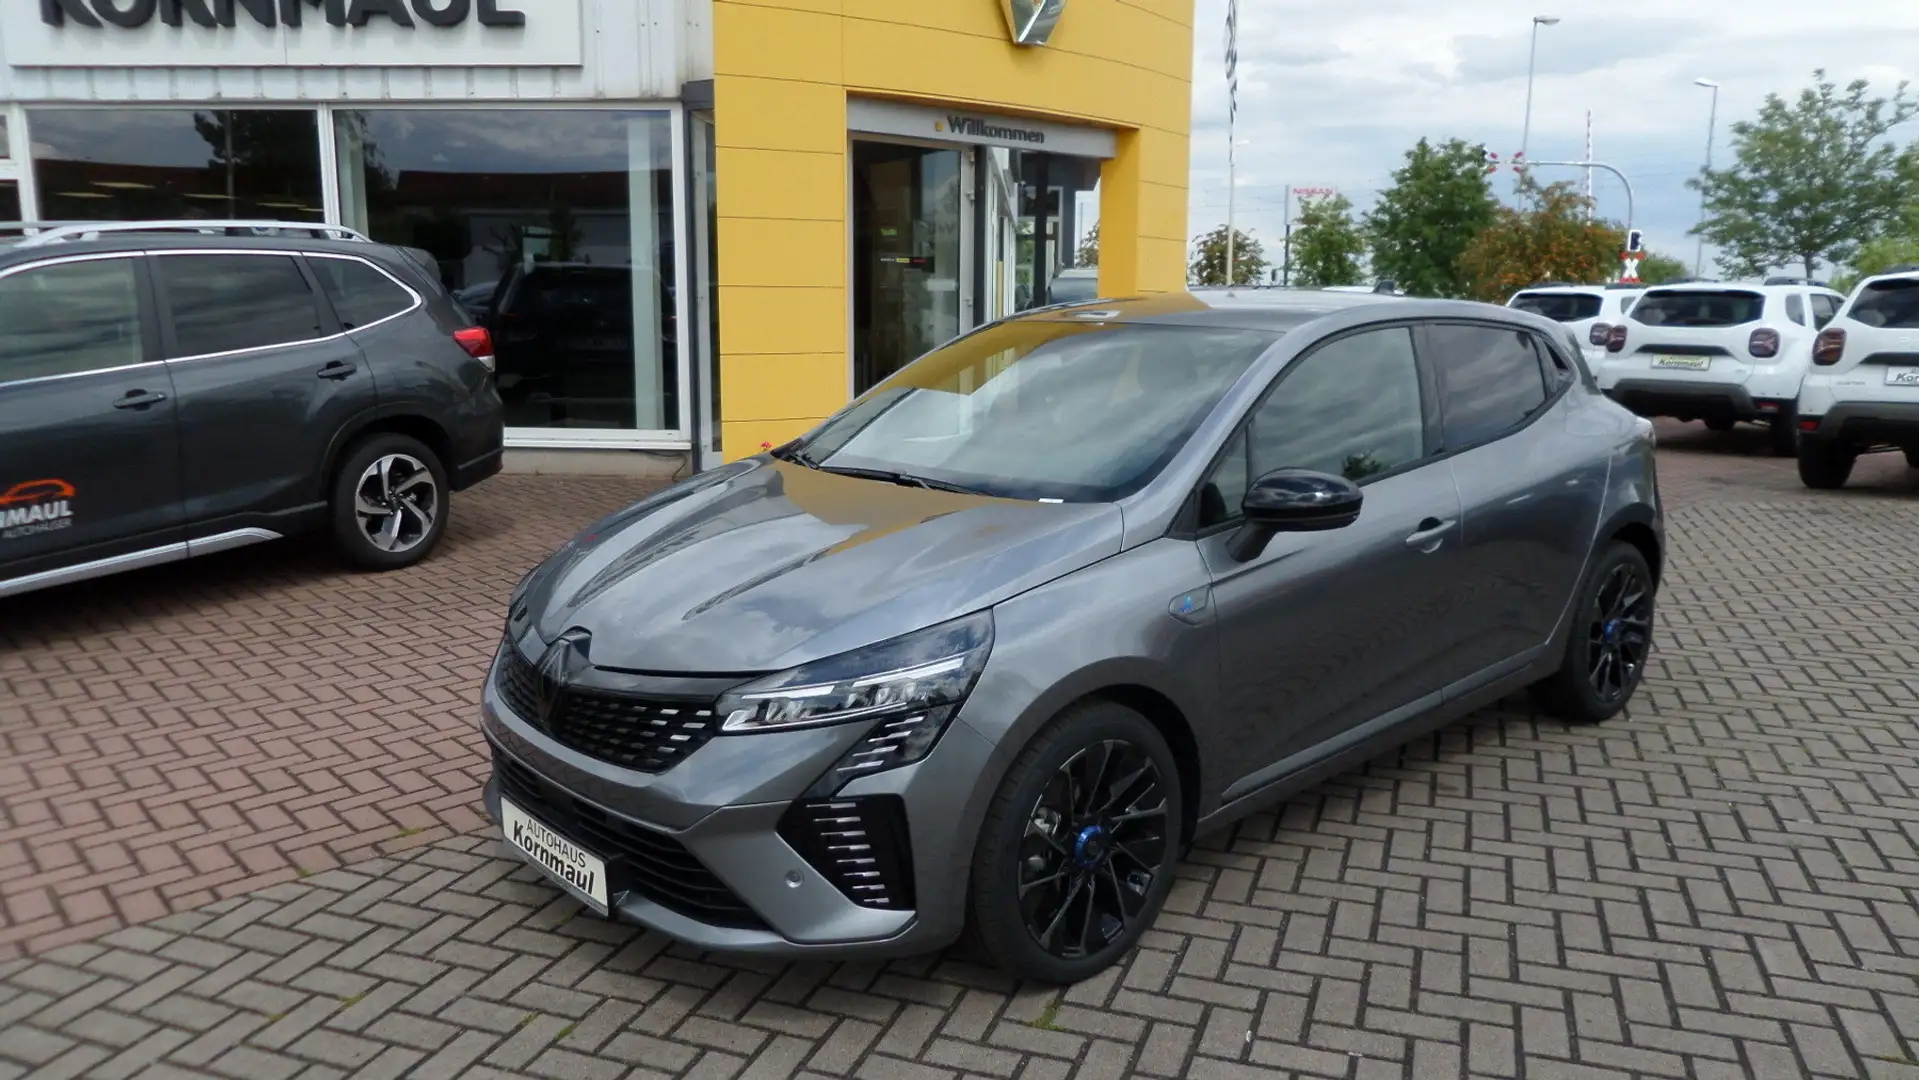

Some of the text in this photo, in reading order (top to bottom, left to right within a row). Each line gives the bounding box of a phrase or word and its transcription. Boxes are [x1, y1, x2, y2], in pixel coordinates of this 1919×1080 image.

[947, 115, 1045, 144] Willkommen
[513, 820, 595, 895] Kornmaul
[526, 818, 587, 868] AUTOHAUS
